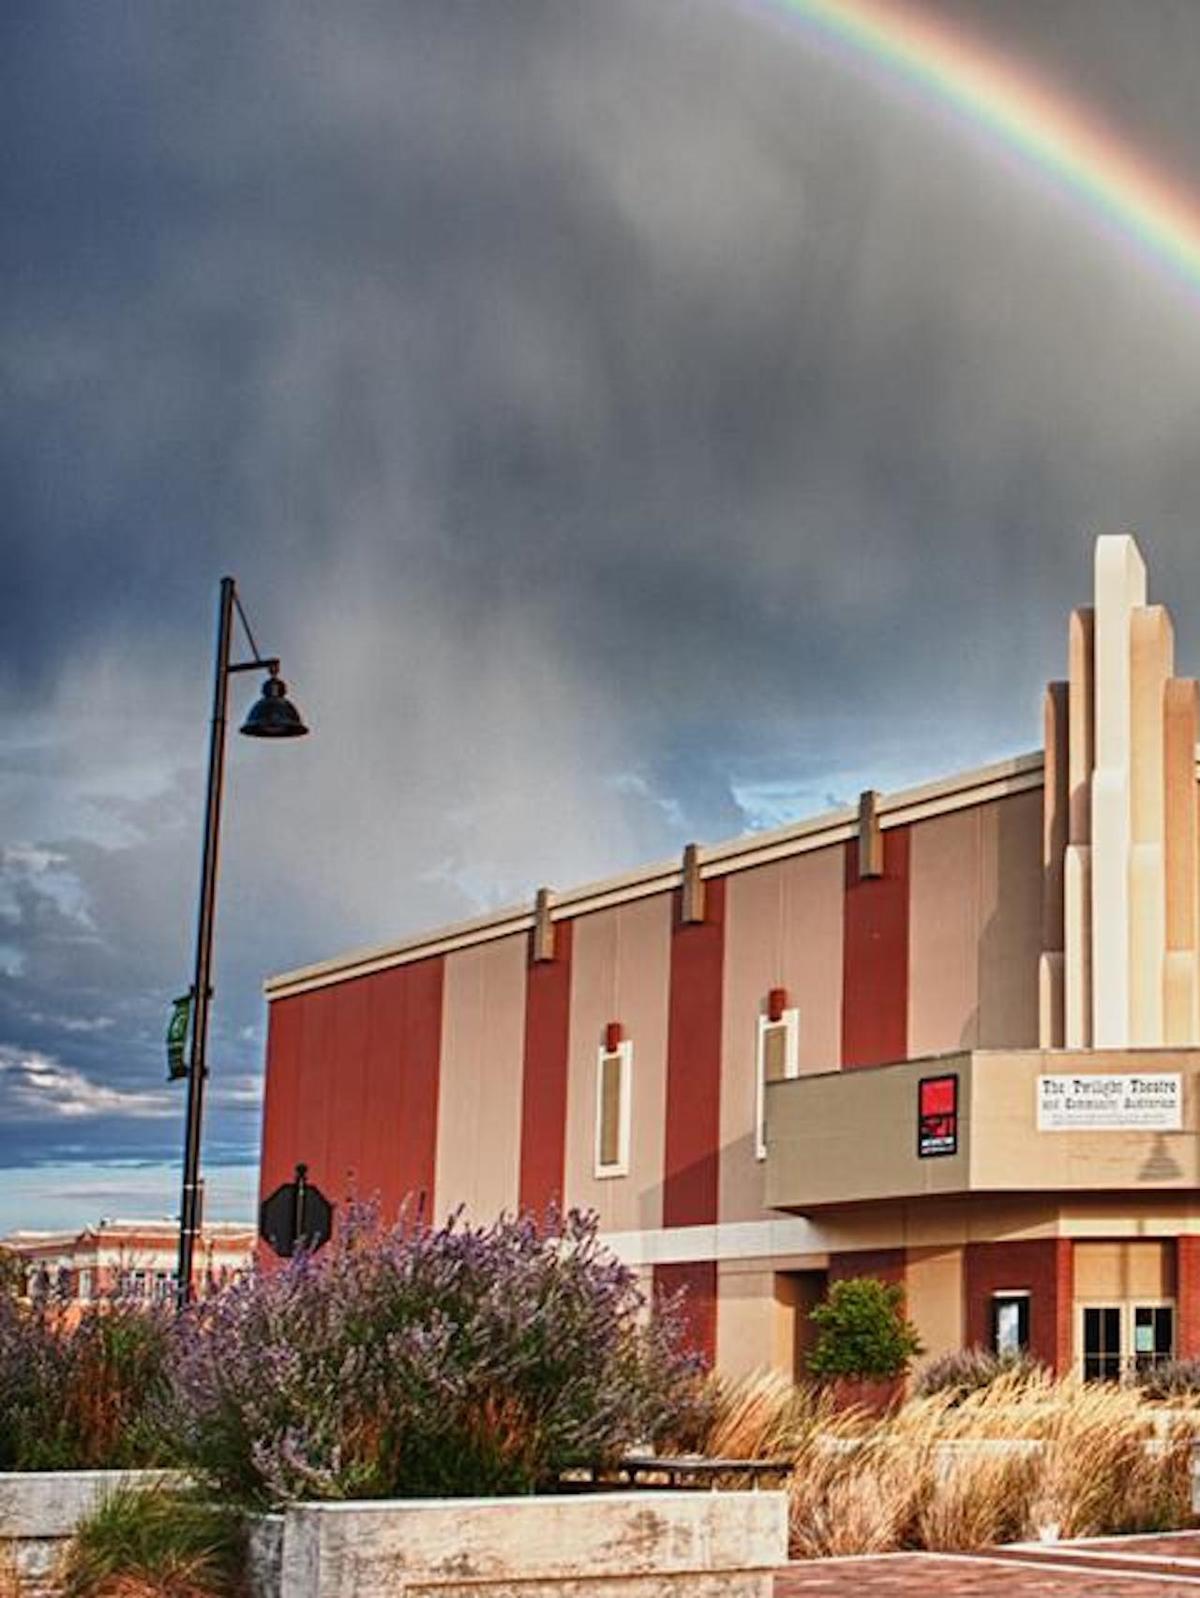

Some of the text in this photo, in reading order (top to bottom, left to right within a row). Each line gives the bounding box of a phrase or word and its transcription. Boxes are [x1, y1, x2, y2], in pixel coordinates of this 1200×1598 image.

[1042, 1079, 1176, 1097] The Twilight Theatre
